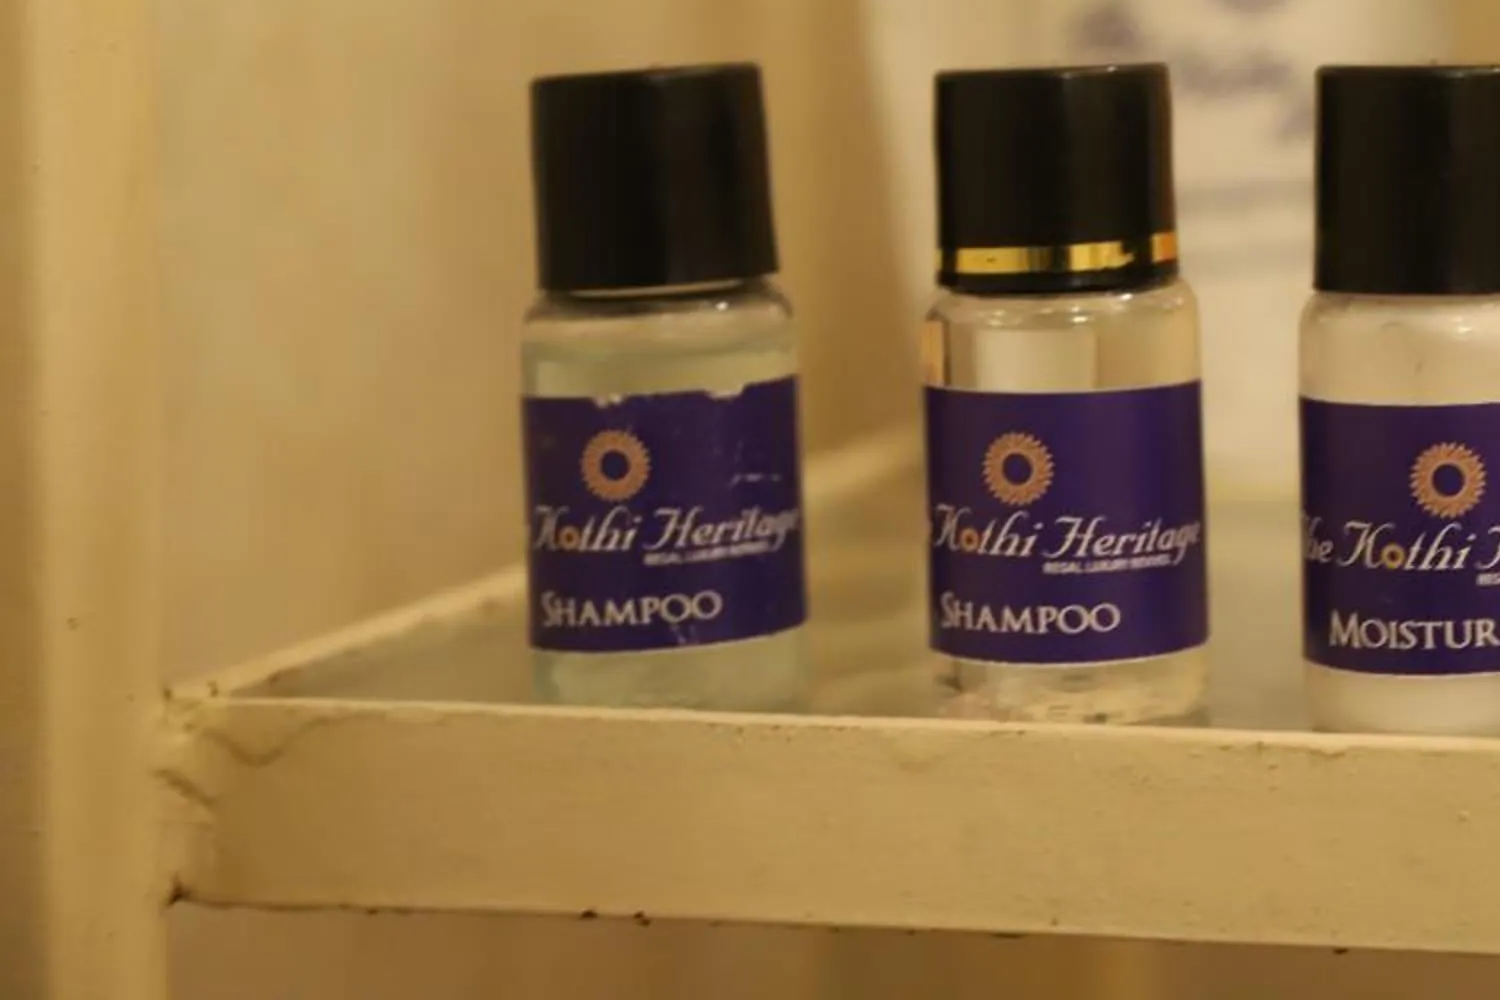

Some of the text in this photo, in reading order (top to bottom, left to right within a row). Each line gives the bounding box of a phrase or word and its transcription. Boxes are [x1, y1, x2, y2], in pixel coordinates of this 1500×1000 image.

[534, 505, 643, 552] Kothi
[933, 503, 1201, 567] Kothi Heritage
[1336, 520, 1478, 572] Kothi
[540, 590, 725, 628] SHAMPOO
[939, 592, 1122, 635] SHAMPOO
